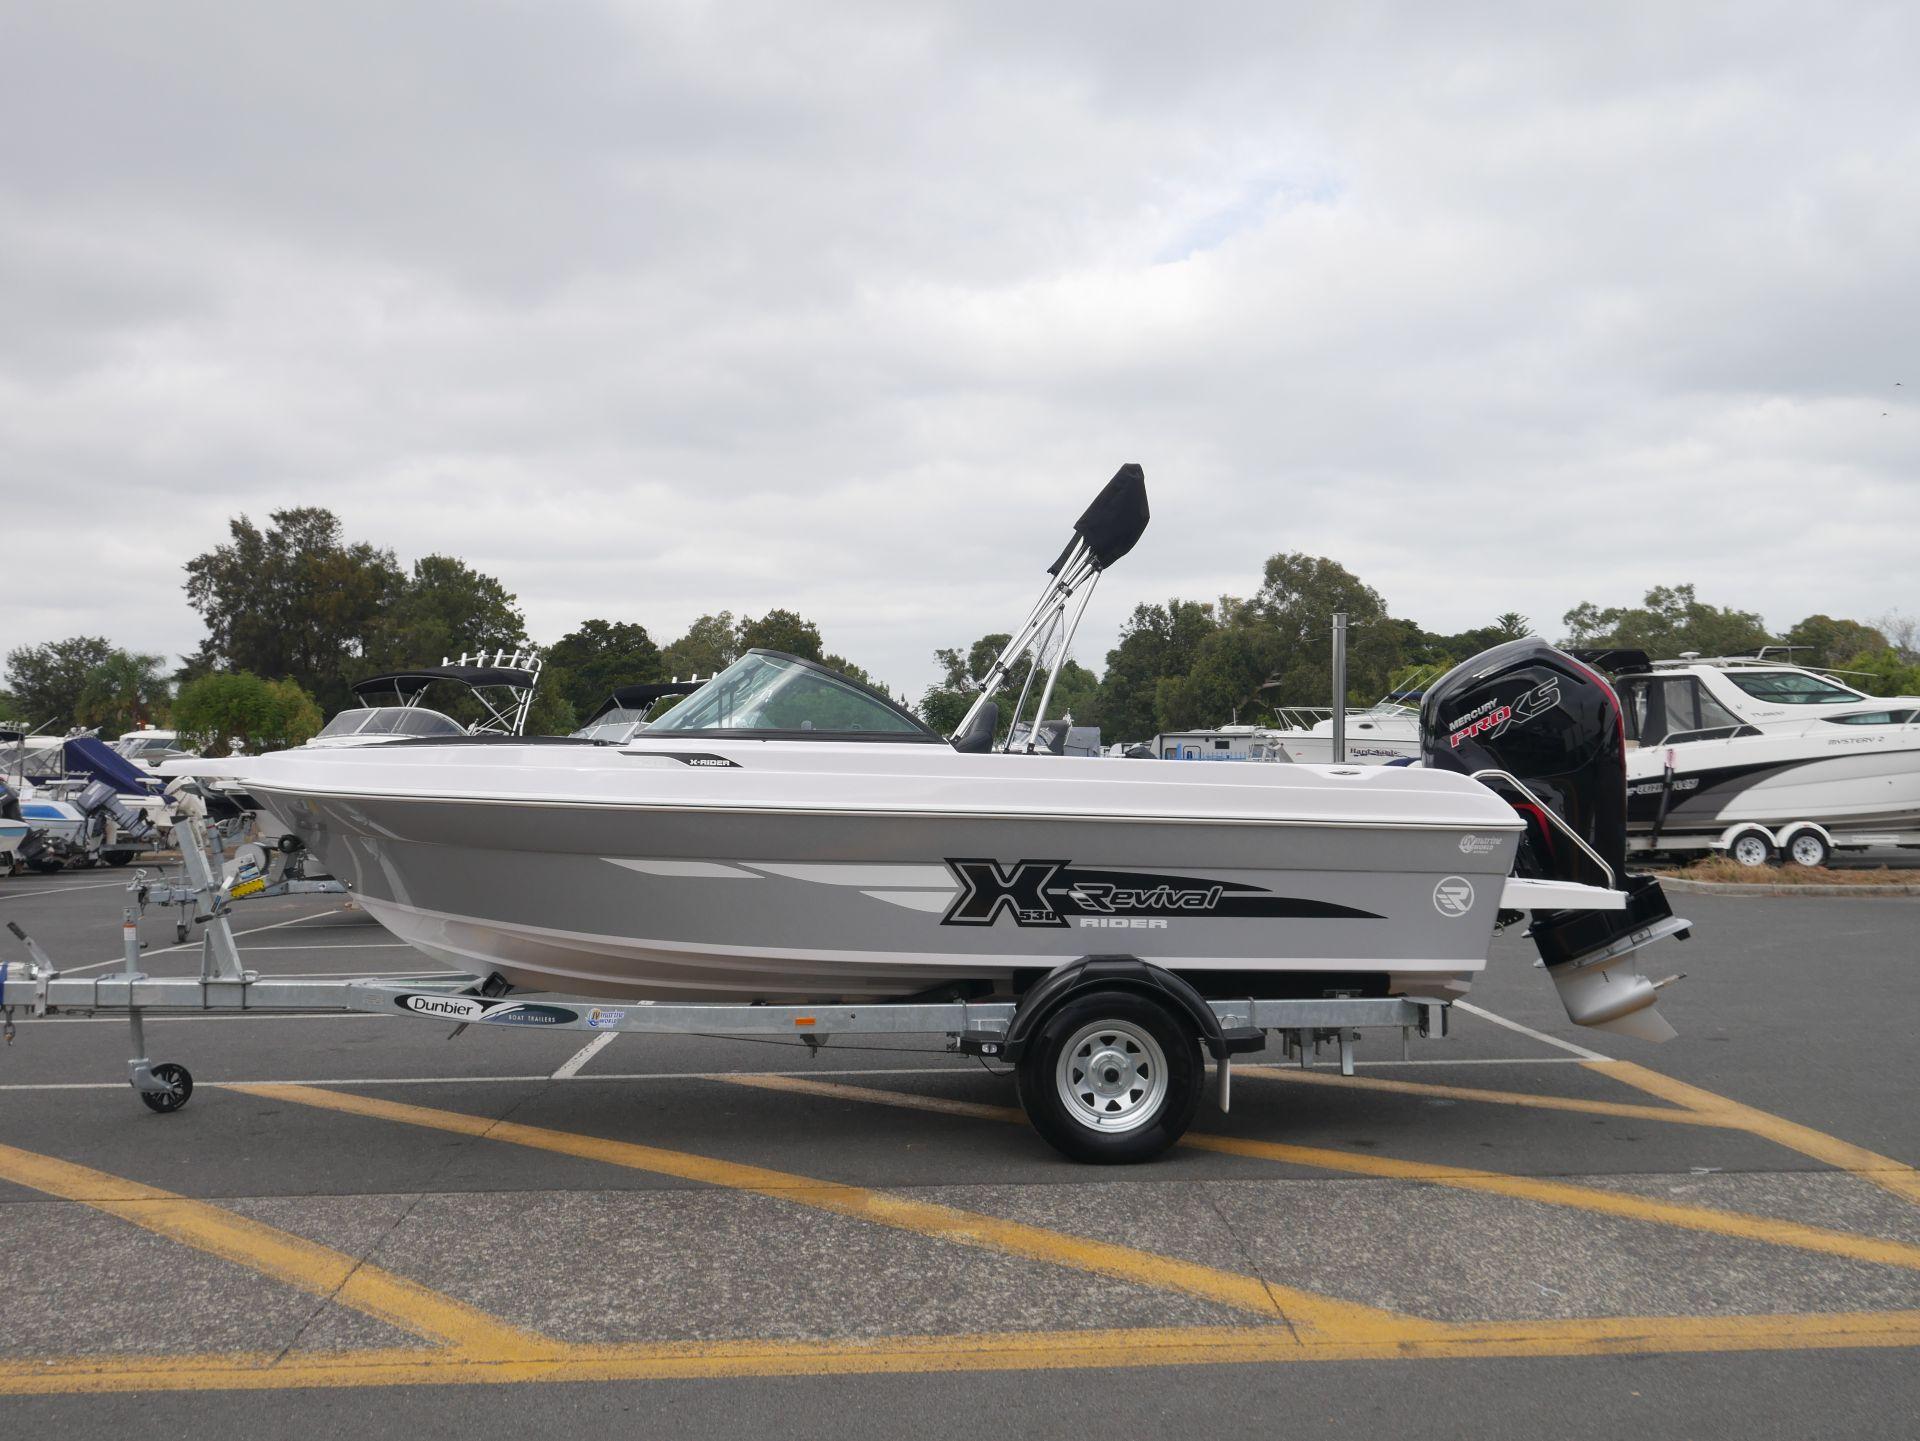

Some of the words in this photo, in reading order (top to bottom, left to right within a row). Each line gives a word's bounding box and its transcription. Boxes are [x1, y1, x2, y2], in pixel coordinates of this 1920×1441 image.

[1449, 698, 1497, 731] MERCURY
[1450, 706, 1511, 748] PRO
[1490, 677, 1560, 739] XS
[690, 759, 730, 767] X-RIDER
[940, 858, 1072, 928] X
[1068, 883, 1223, 912] Revival
[1020, 911, 1057, 921] 530
[1080, 918, 1168, 929] RIDER
[414, 998, 473, 1016] Dunbier
